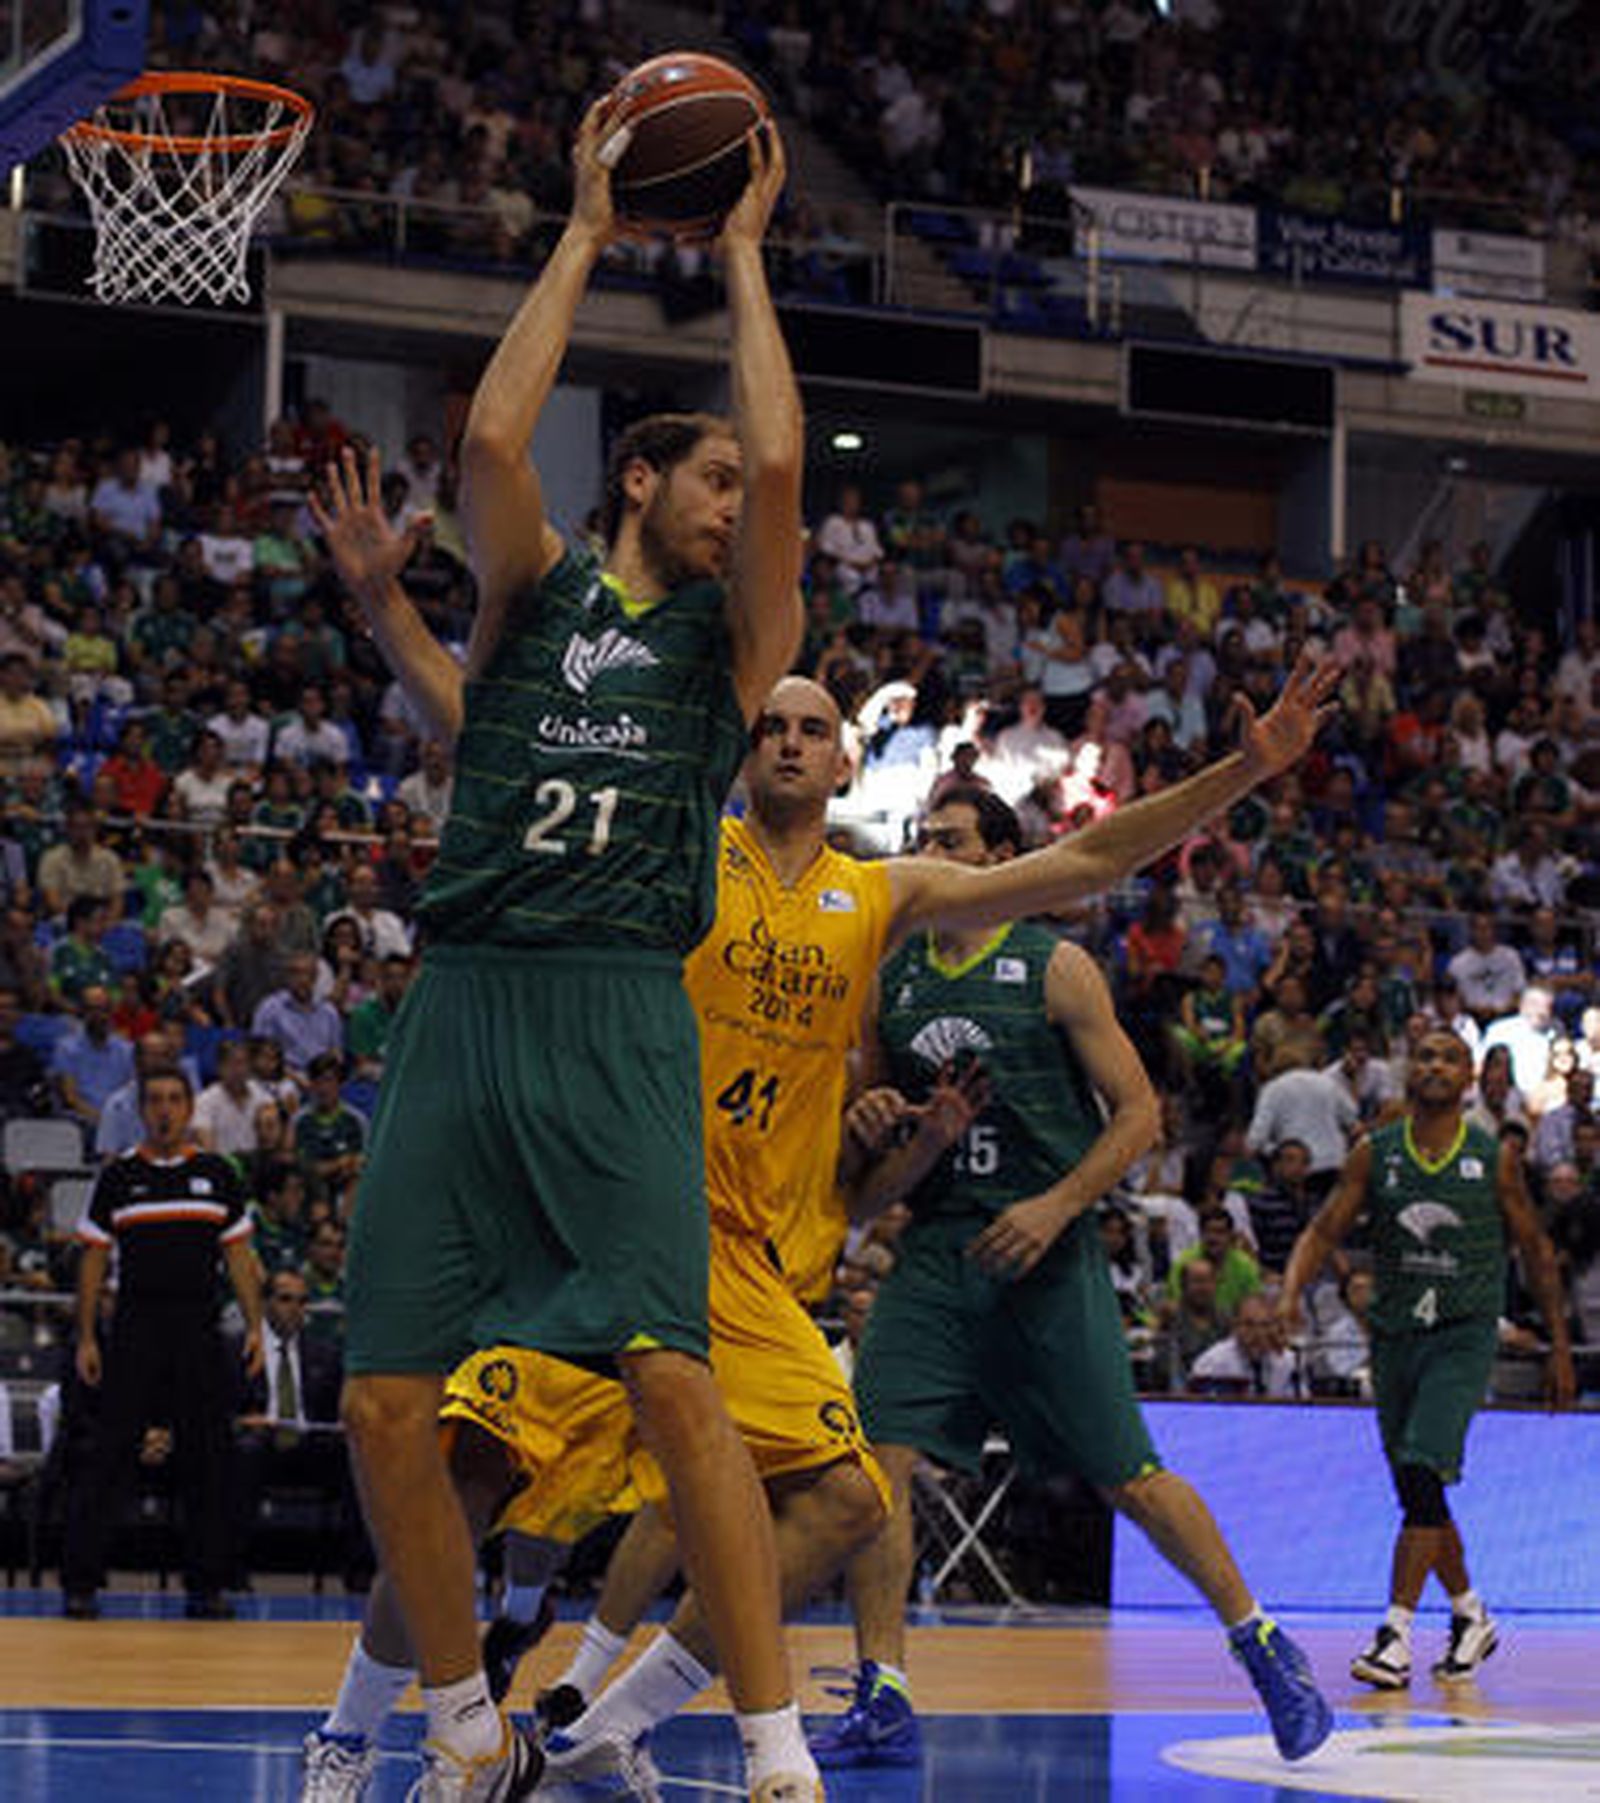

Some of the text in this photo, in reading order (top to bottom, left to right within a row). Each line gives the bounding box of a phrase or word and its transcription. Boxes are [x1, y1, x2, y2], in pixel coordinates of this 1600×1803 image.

[1429, 313, 1577, 366] SUR
[538, 713, 648, 749] Unicaja
[522, 778, 619, 855] 21
[716, 1068, 780, 1132] 41
[1413, 1286, 1438, 1328] 4
